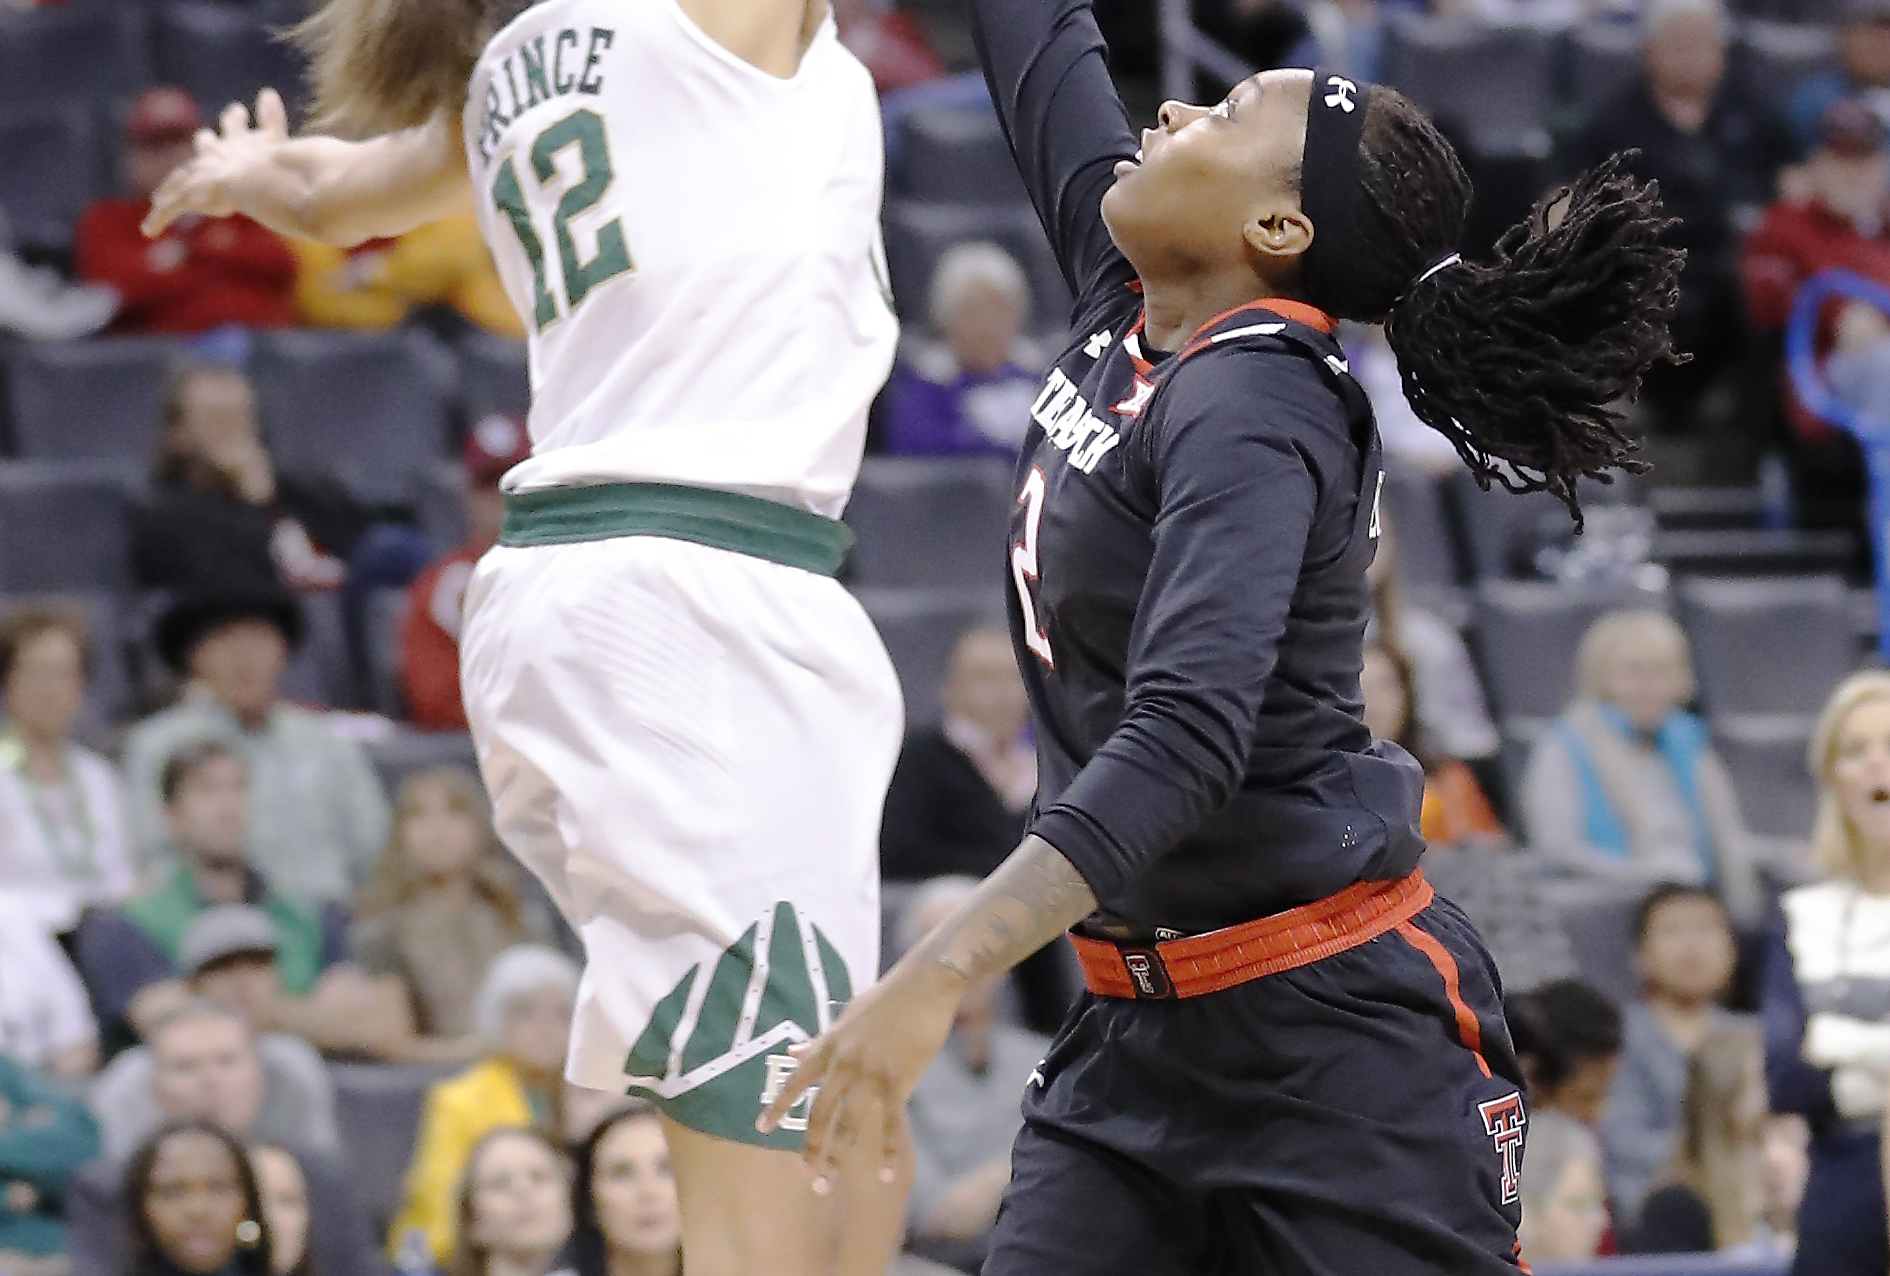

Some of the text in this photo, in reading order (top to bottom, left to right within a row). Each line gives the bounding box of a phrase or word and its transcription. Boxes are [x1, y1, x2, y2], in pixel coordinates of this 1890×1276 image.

[479, 25, 615, 167] RINCE
[491, 106, 636, 333] 12
[1011, 462, 1054, 672] 2
